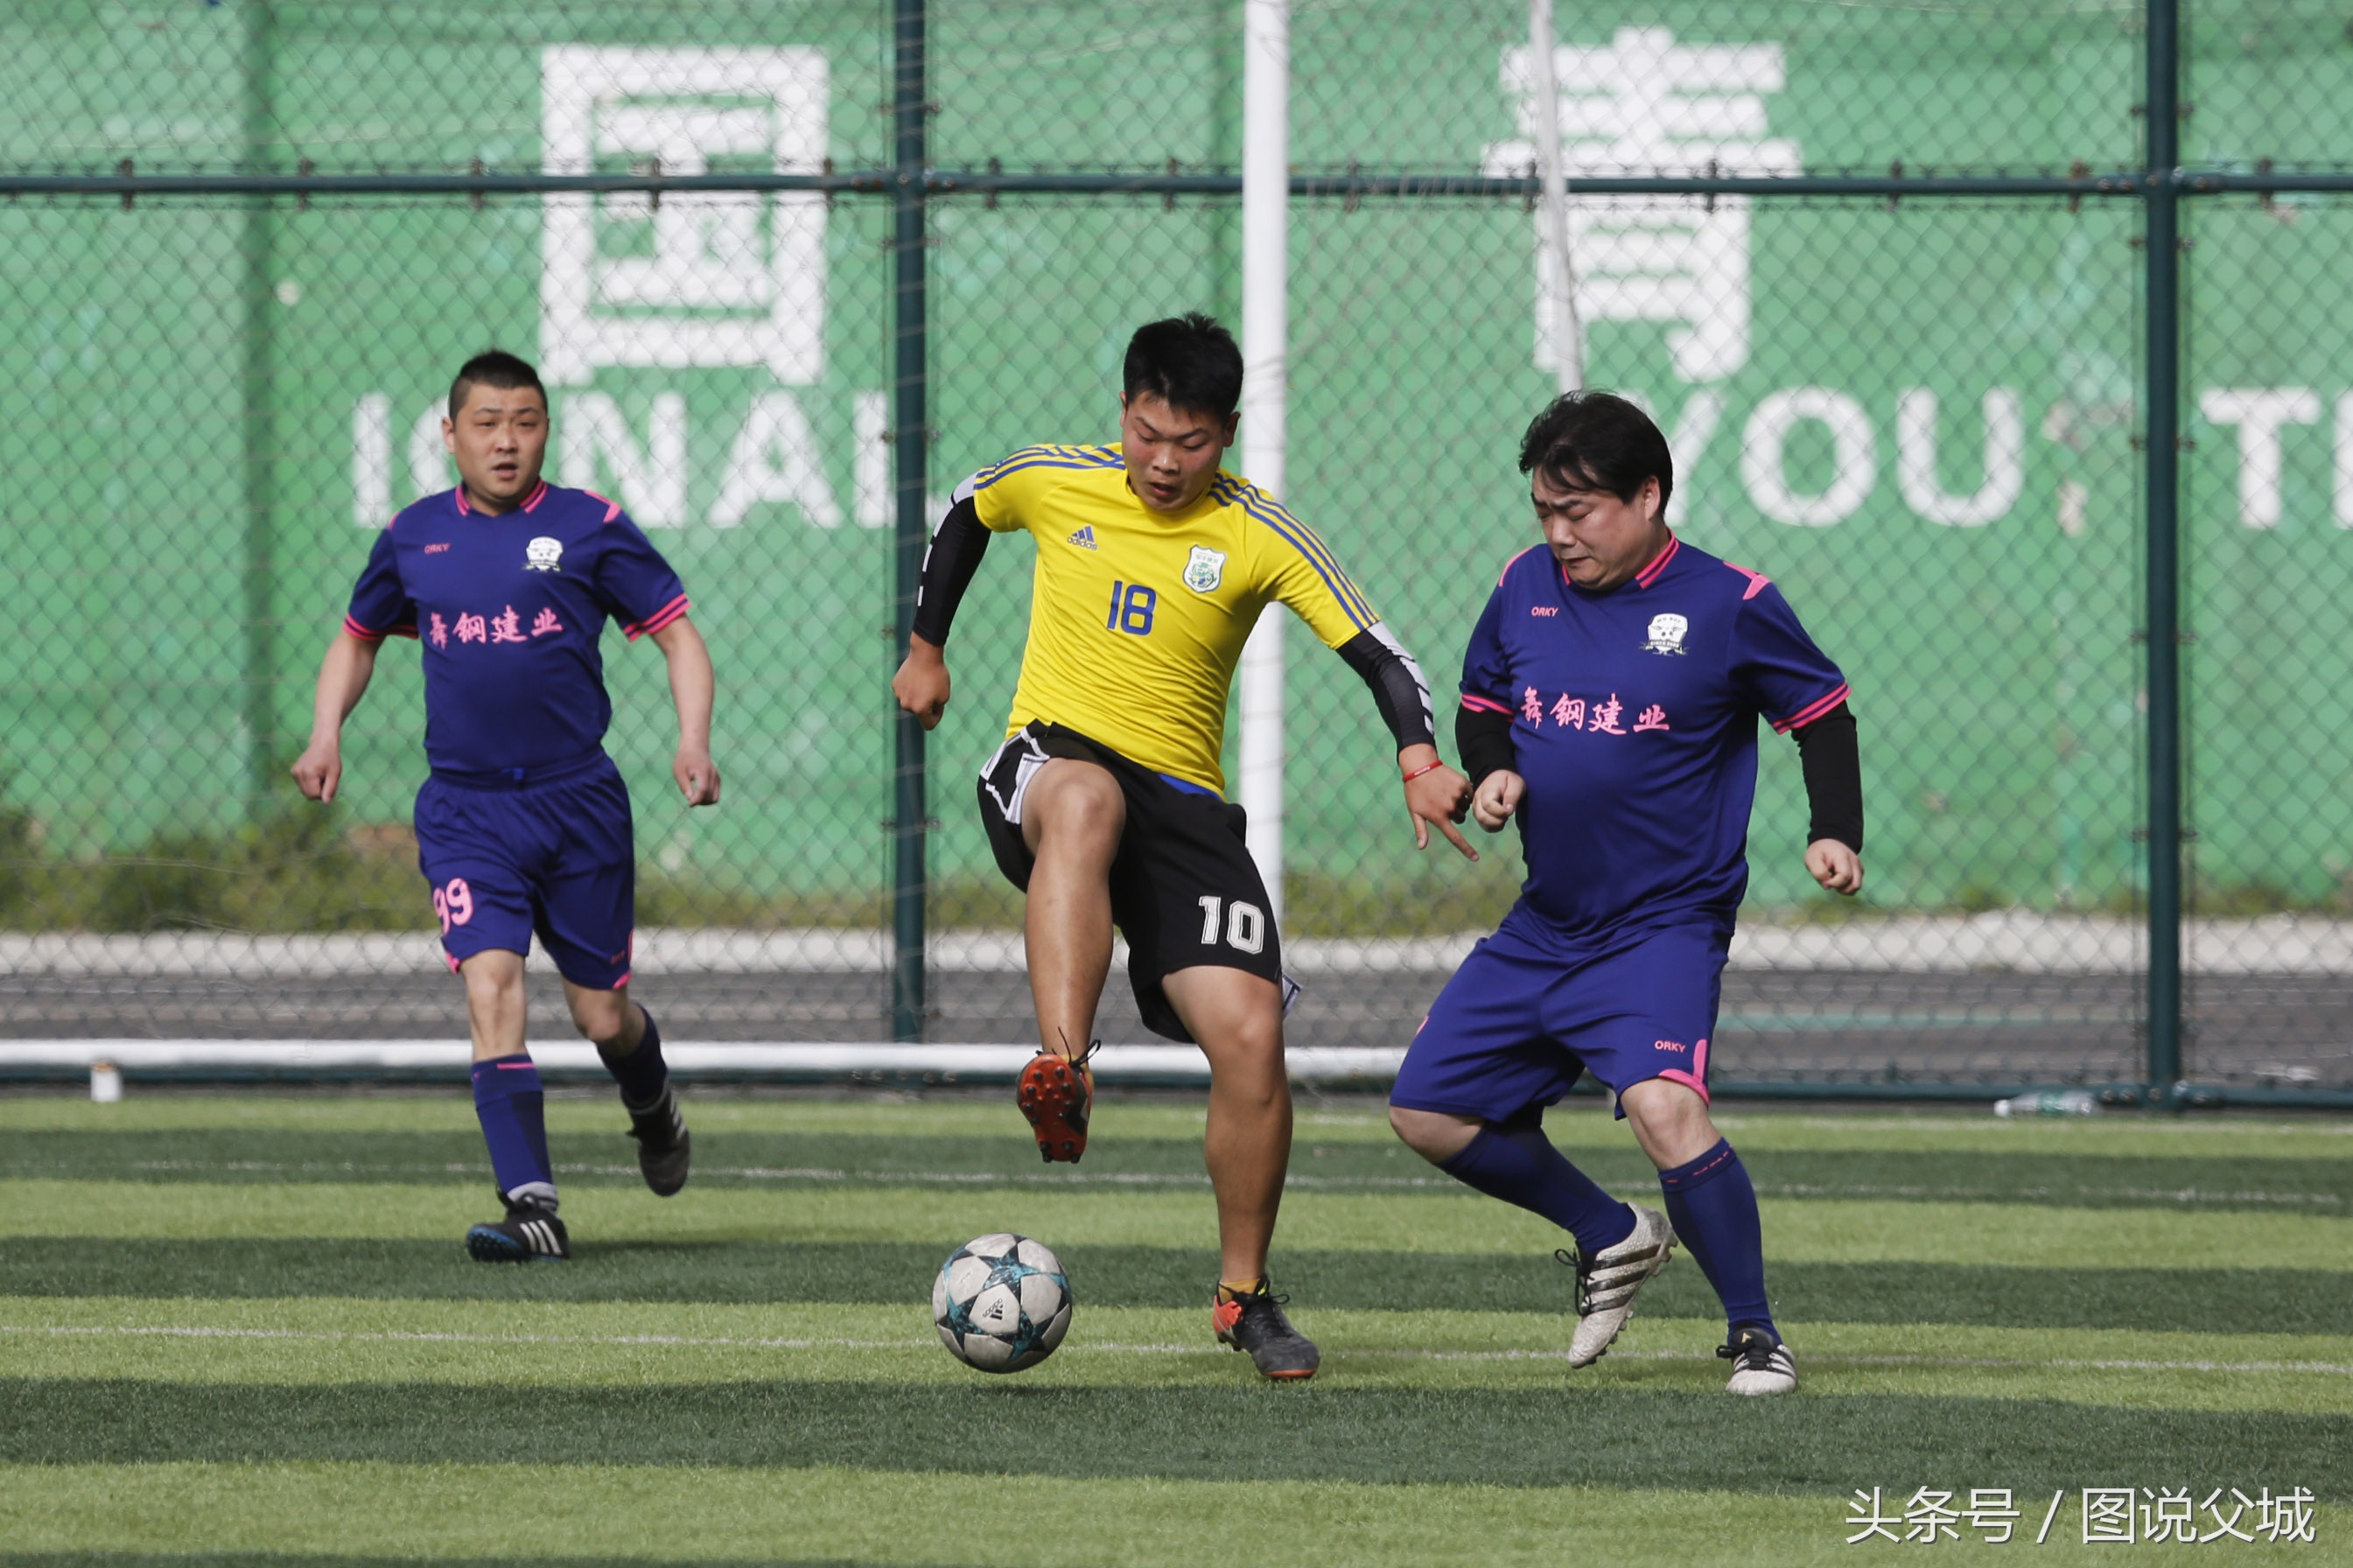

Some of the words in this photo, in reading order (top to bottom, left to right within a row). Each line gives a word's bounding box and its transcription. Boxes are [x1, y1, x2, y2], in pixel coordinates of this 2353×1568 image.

[539, 43, 828, 385] 国
[1481, 25, 1800, 382] 青
[354, 391, 942, 528] INAL
[1067, 536, 1097, 551] adidas
[1108, 580, 1157, 635] 18
[1531, 606, 1558, 617] ORKY
[433, 878, 473, 935] 99
[1199, 895, 1264, 955] 10
[1655, 1040, 1685, 1053] ORKY
